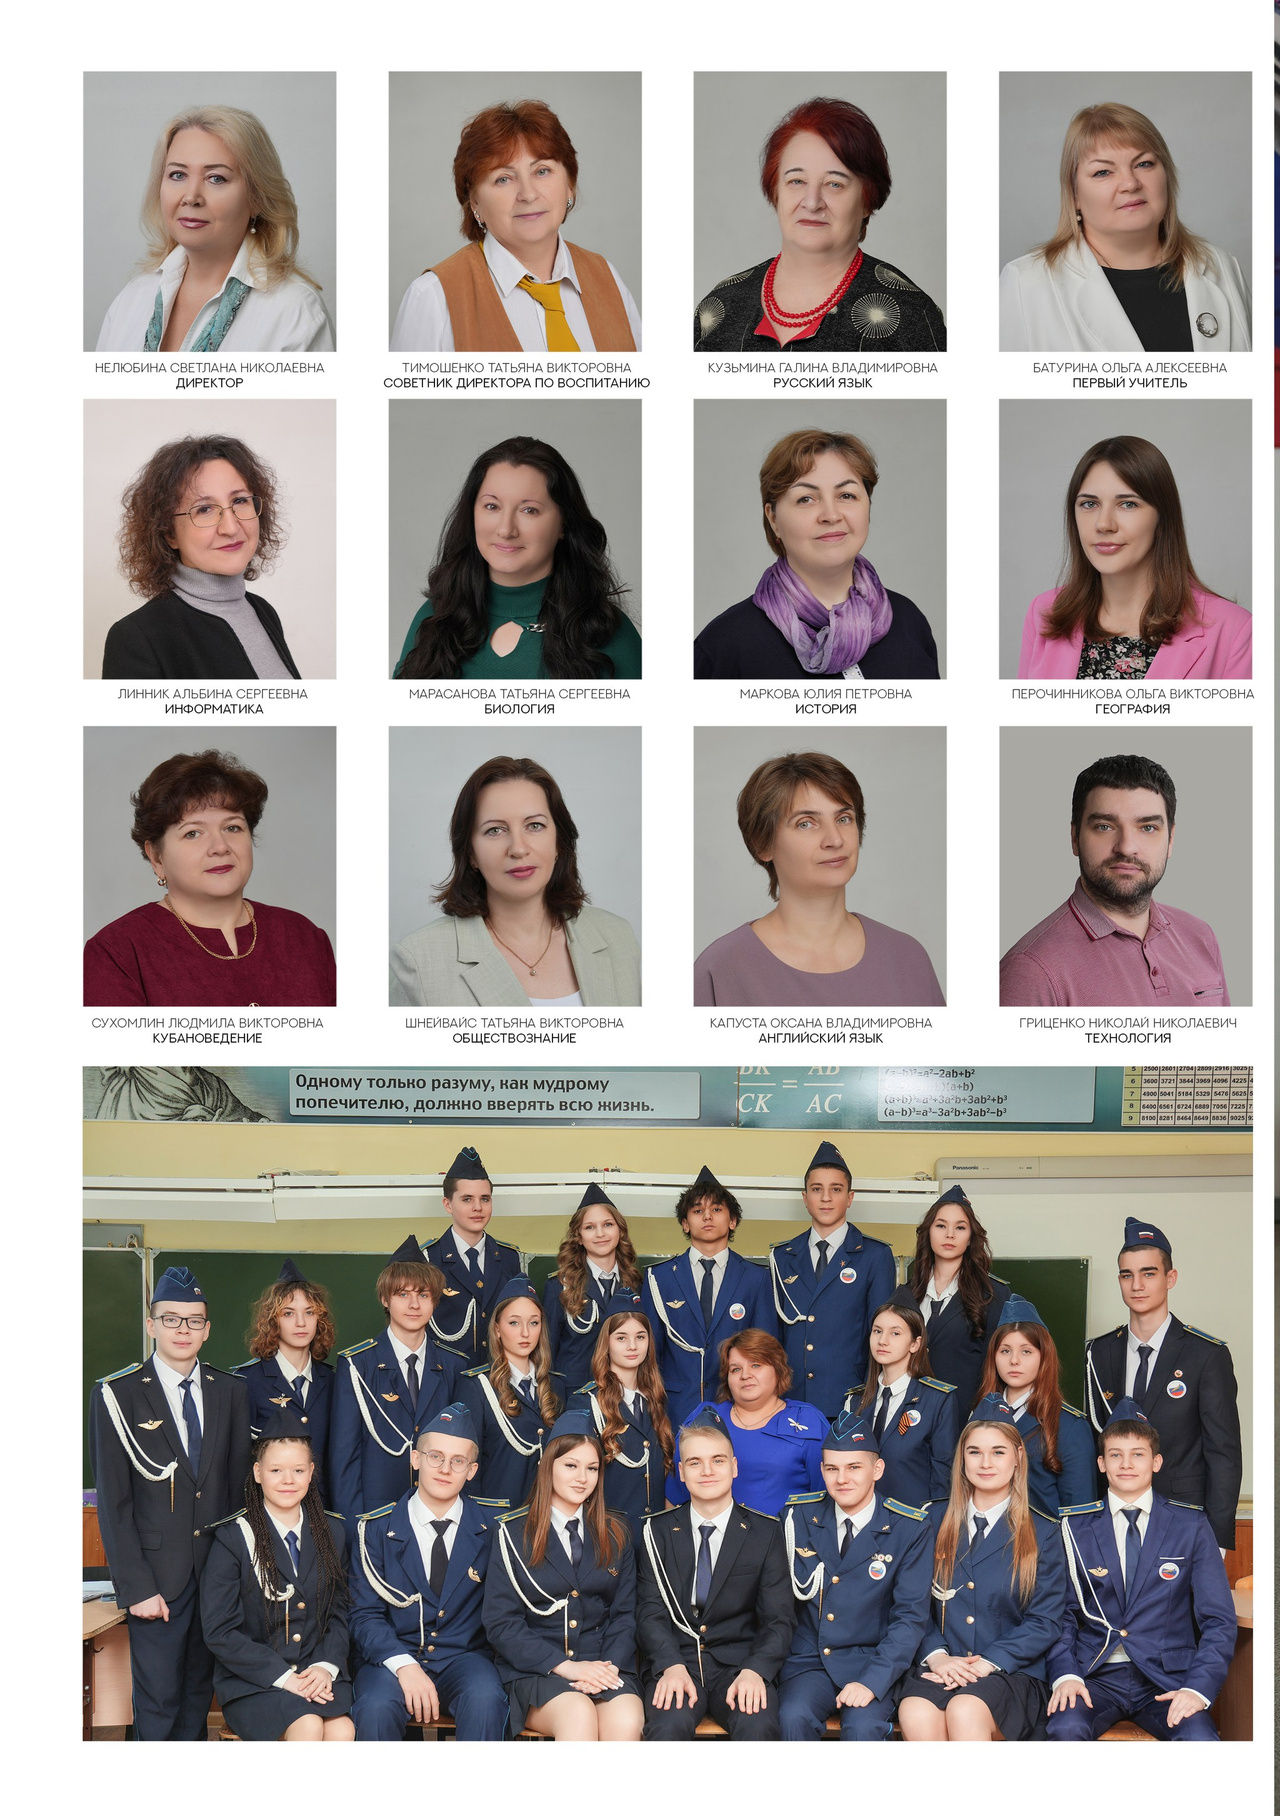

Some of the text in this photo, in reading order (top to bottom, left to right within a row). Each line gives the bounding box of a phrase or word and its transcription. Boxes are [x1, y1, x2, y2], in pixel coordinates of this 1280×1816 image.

[296, 1074, 609, 1093] Одному только разуму, как мудрому
[296, 1097, 655, 1113] попечителю, должно вверять всю жизнь.
[736, 1093, 773, 1113] CK
[805, 1093, 842, 1113] AC
